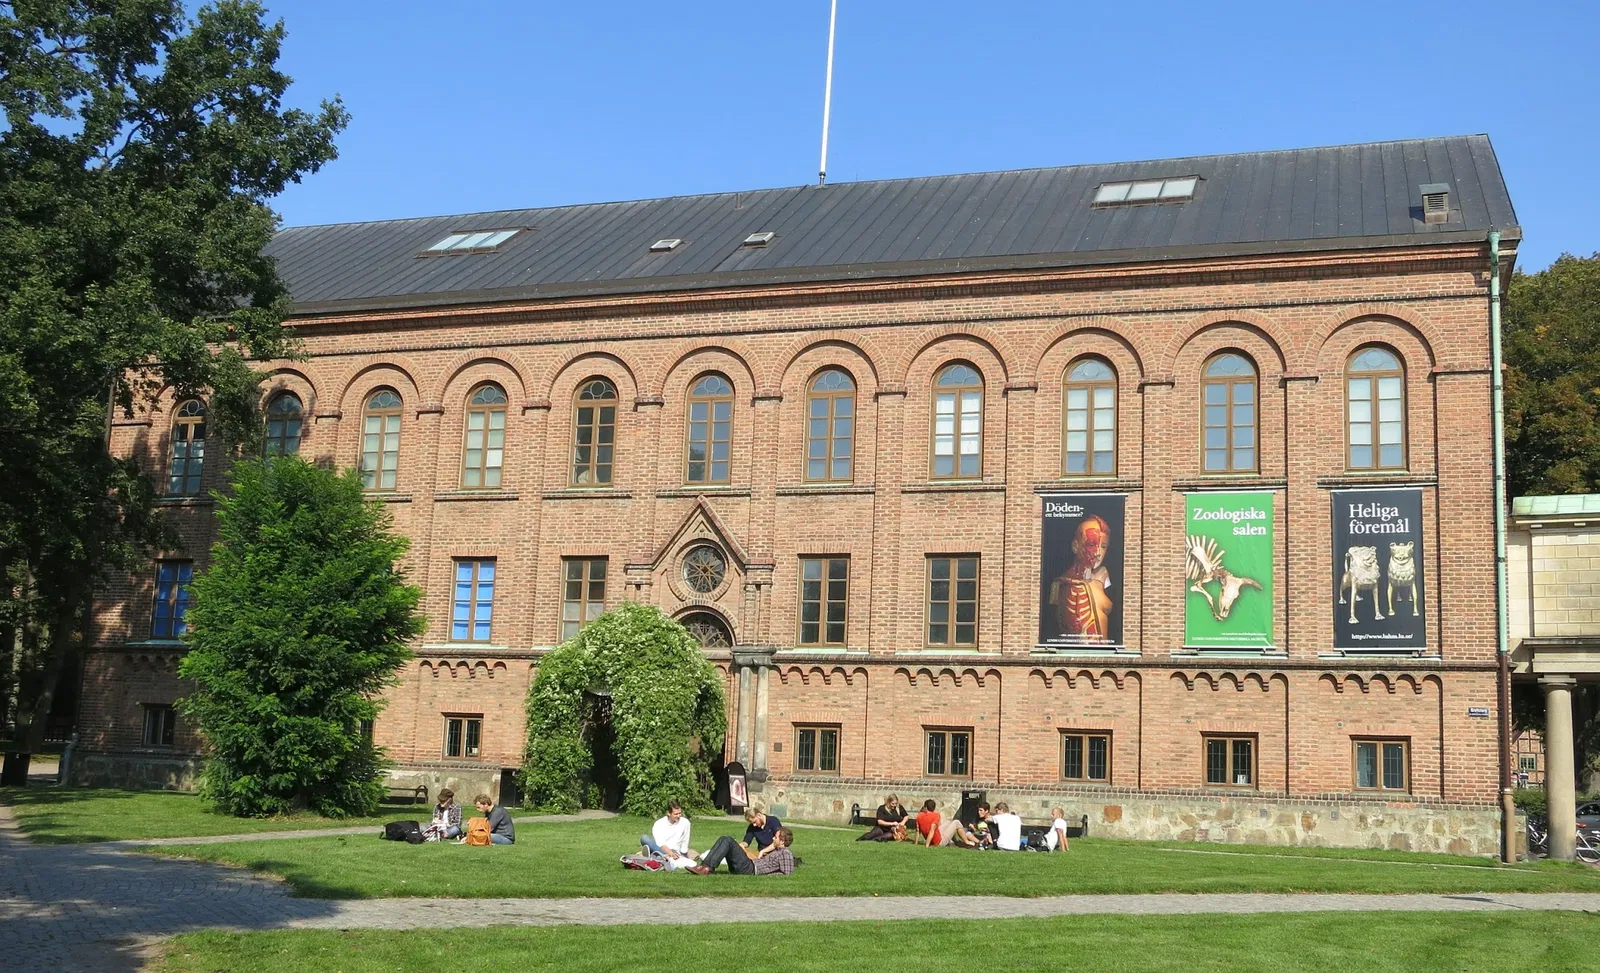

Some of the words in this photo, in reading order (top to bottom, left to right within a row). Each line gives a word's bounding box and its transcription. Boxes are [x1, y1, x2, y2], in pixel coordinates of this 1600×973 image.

[1192, 506, 1266, 524] Zoologiska
[1349, 502, 1399, 521] Heliga
[1232, 522, 1267, 535] salen
[1349, 517, 1409, 534] föremål
